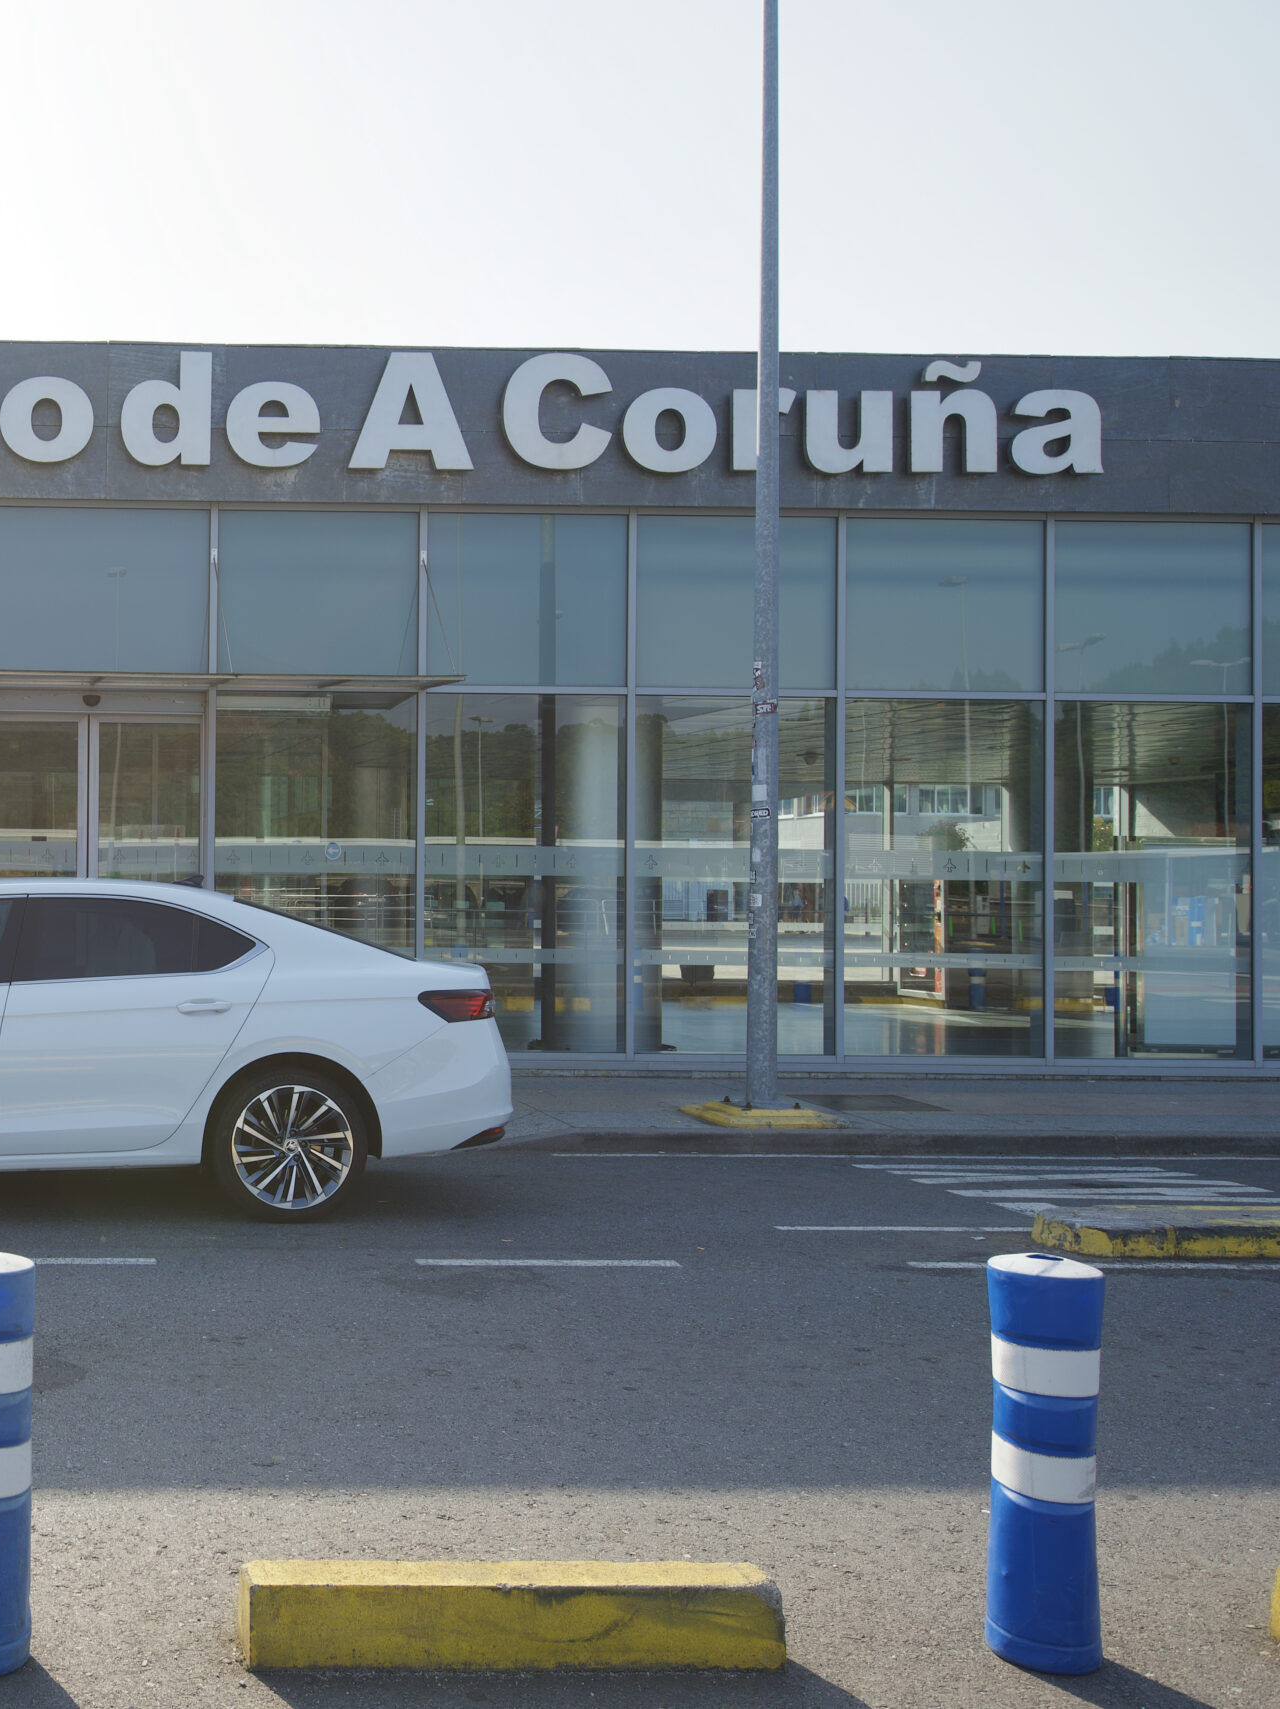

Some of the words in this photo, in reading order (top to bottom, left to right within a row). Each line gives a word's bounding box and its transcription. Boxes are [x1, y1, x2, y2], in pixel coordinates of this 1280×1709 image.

[120, 351, 321, 468] de
[347, 351, 475, 472] A
[501, 352, 1105, 475] Coruña
